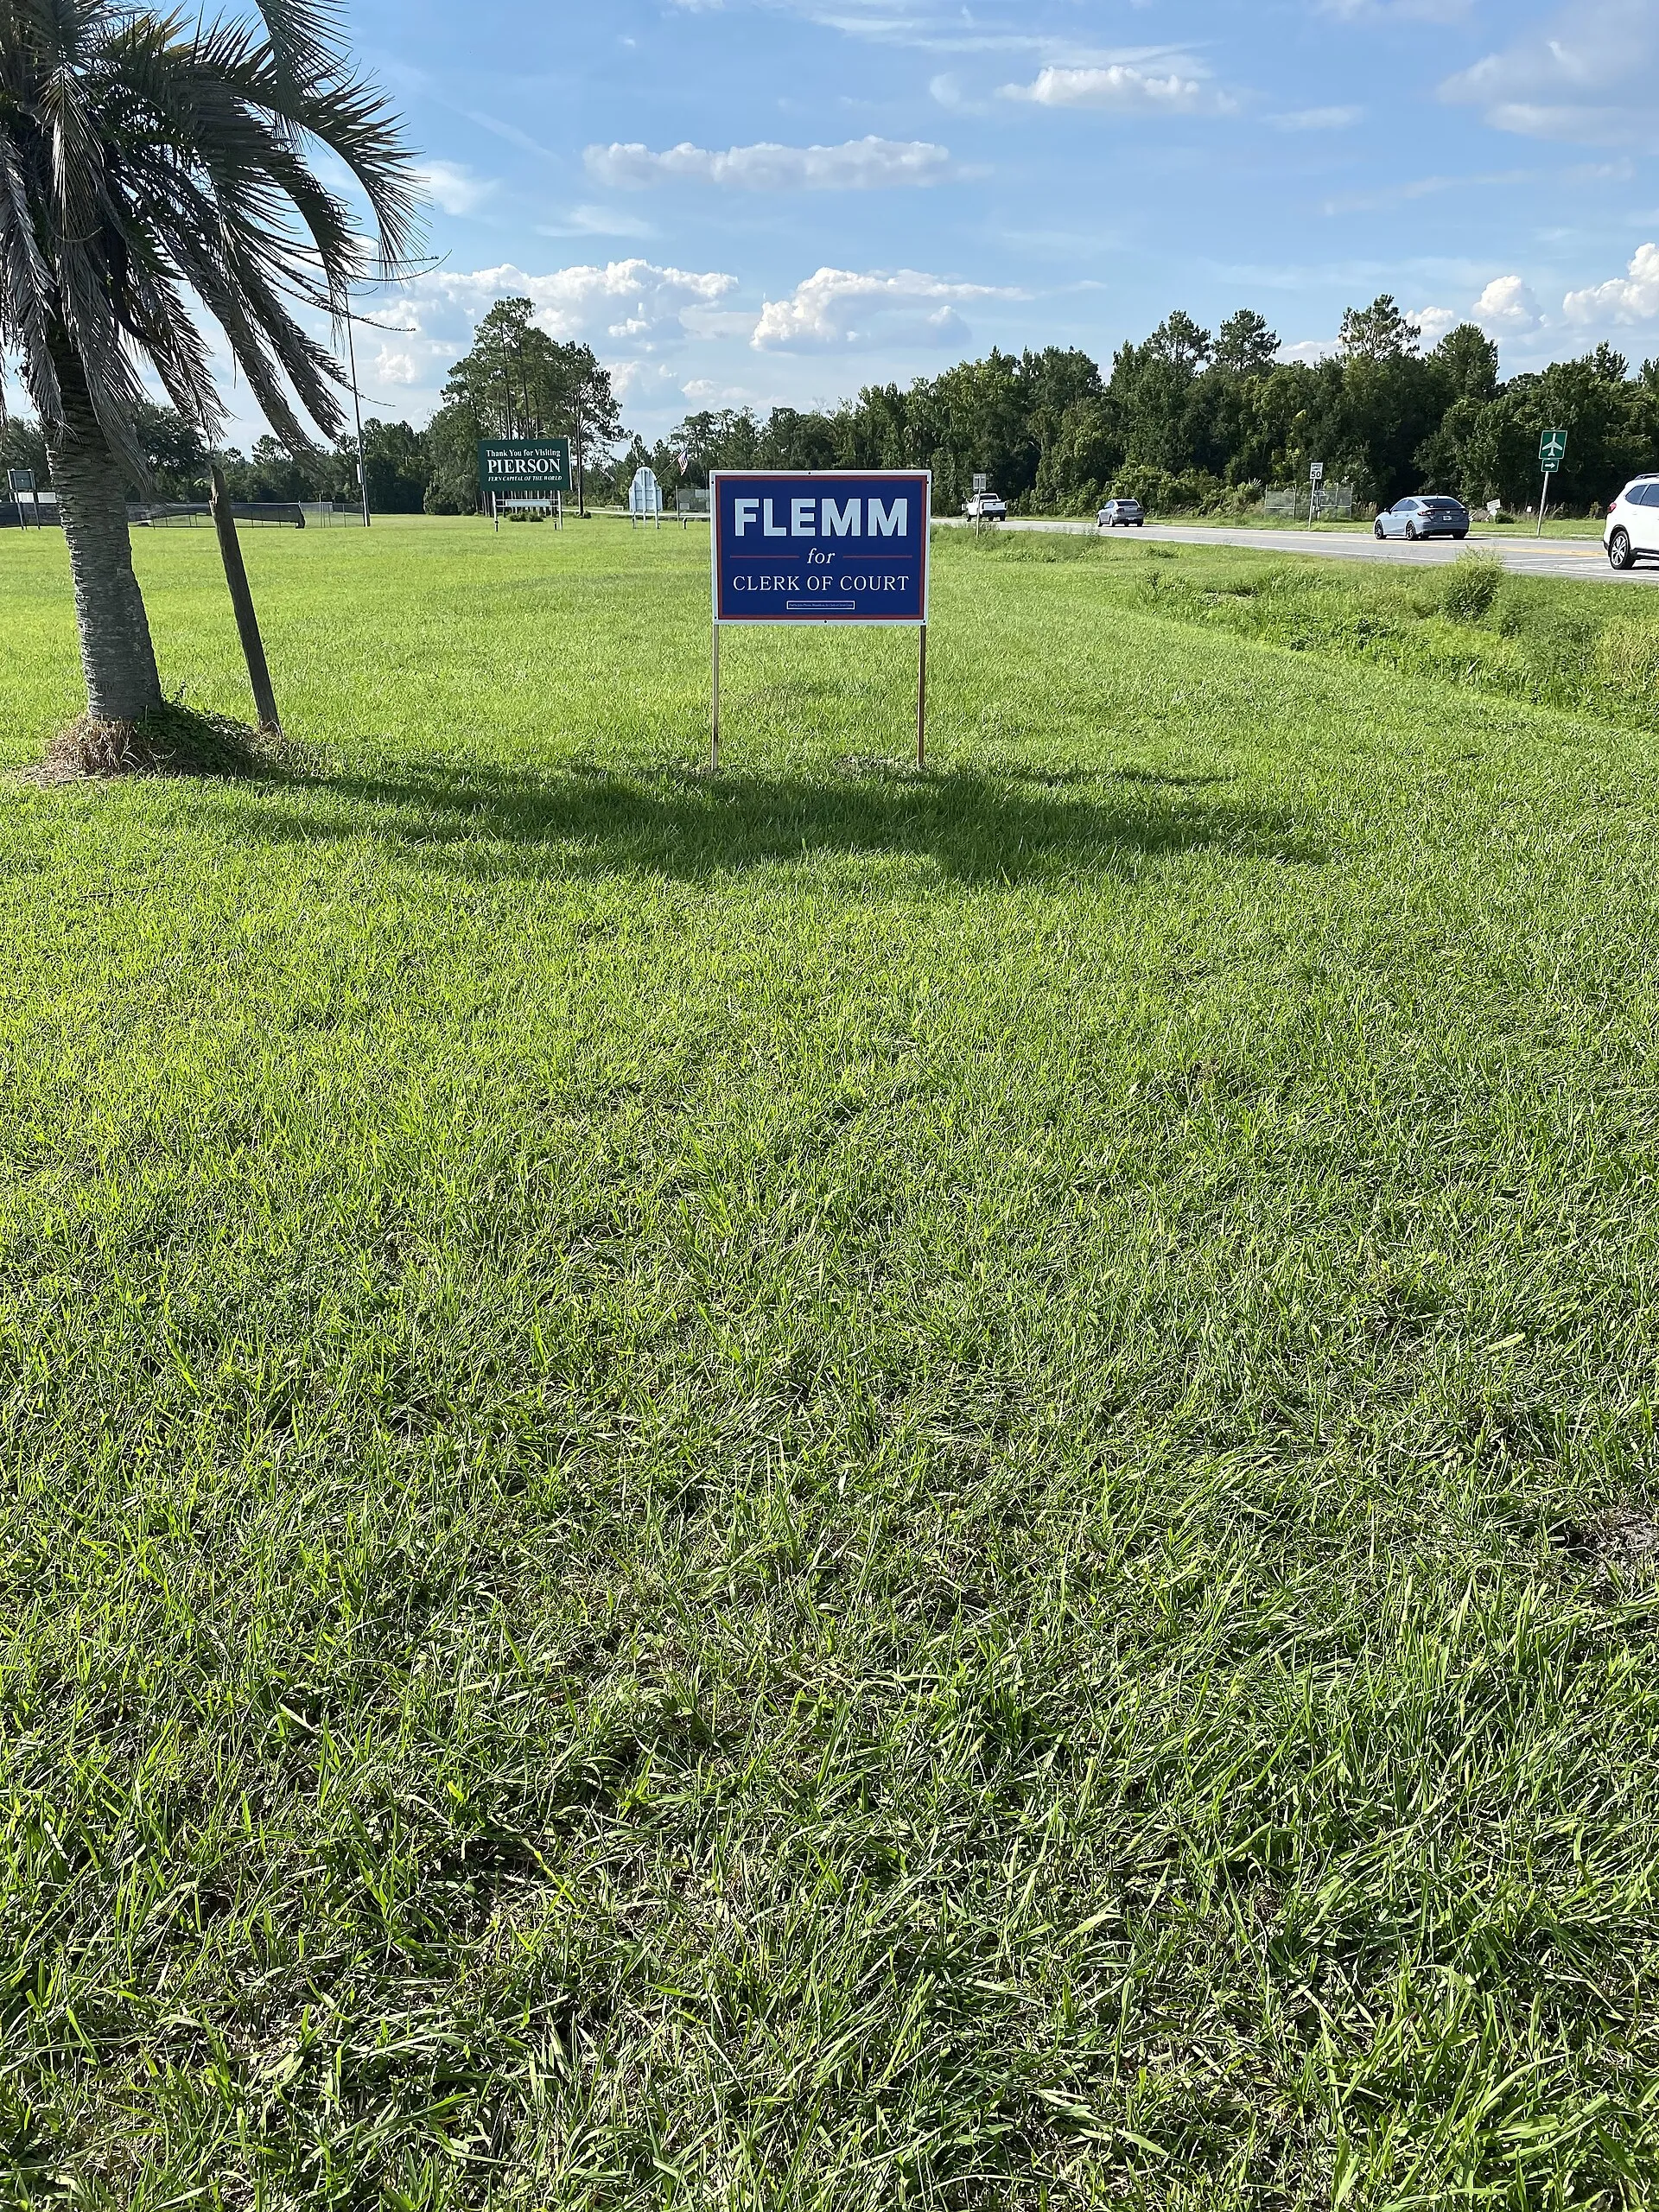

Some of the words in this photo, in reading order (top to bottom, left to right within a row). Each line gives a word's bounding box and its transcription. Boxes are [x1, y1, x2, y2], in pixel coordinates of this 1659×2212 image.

[509, 448, 522, 457] You
[535, 448, 561, 457] Visiting
[486, 459, 561, 473] PIERSON
[734, 498, 908, 537] FLEMM
[807, 548, 836, 564] for
[733, 575, 800, 591] CLERK
[806, 575, 834, 591] OF
[840, 575, 910, 591] COURT
